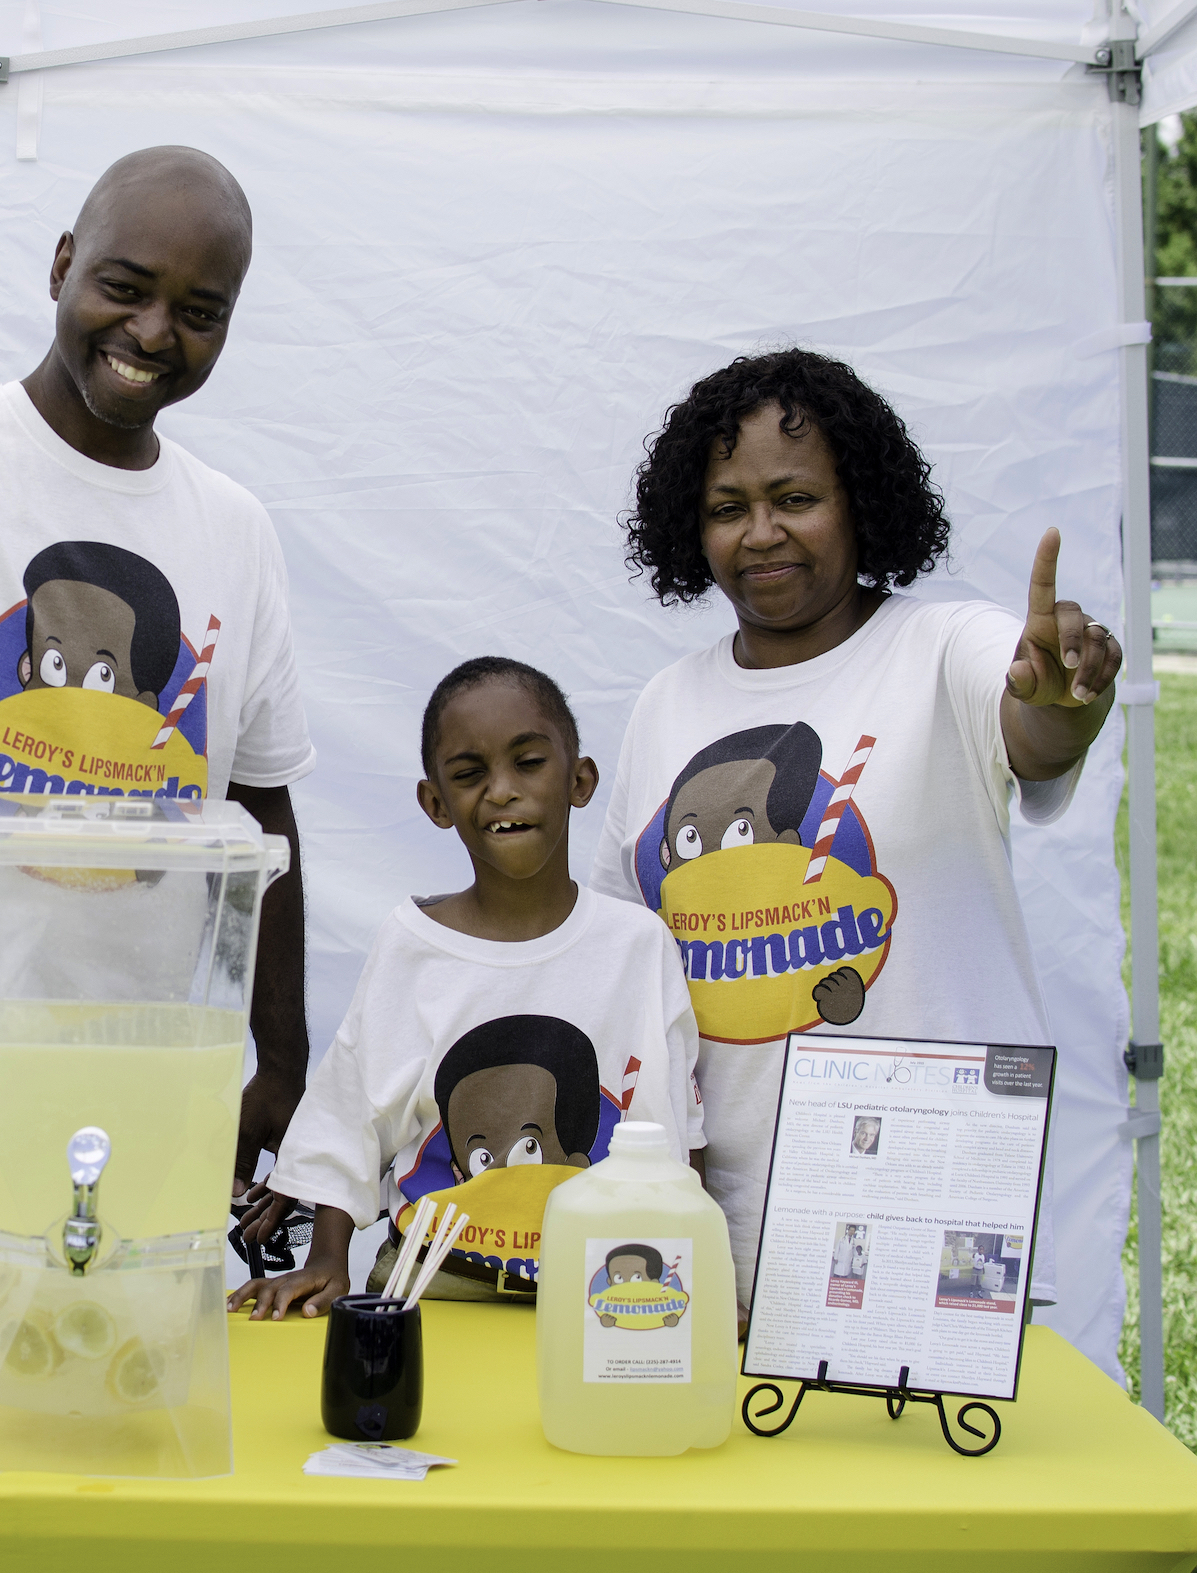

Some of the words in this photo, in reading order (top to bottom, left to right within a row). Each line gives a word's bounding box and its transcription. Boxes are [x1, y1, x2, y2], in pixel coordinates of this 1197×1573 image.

[2, 727, 75, 769] LEROY'S
[79, 754, 166, 782] LIPSMACK'N
[667, 912, 726, 932] LEROY'S
[731, 896, 831, 931] LIPSMACK'N
[676, 904, 892, 982] monade
[794, 1058, 869, 1080] CLINIC
[994, 1055, 1030, 1063] Otolaryngology
[808, 1099, 827, 1108] head
[854, 1103, 888, 1112] pediatric
[889, 1106, 950, 1117] otolaryngology
[950, 1109, 968, 1117] joins
[969, 1110, 1006, 1119] Children's
[1007, 1112, 1039, 1122] Hospital
[774, 1205, 811, 1215] Lemonade
[812, 1208, 828, 1216] with
[834, 1211, 865, 1219] purpose:
[866, 1212, 884, 1220] child
[885, 1214, 904, 1222] gives
[905, 1215, 923, 1223] back
[933, 1217, 964, 1227] hospital
[982, 1221, 1008, 1230] helped
[1009, 1223, 1025, 1231] him
[431, 1216, 506, 1248] LOY'S
[594, 1298, 685, 1315] Lemonade
